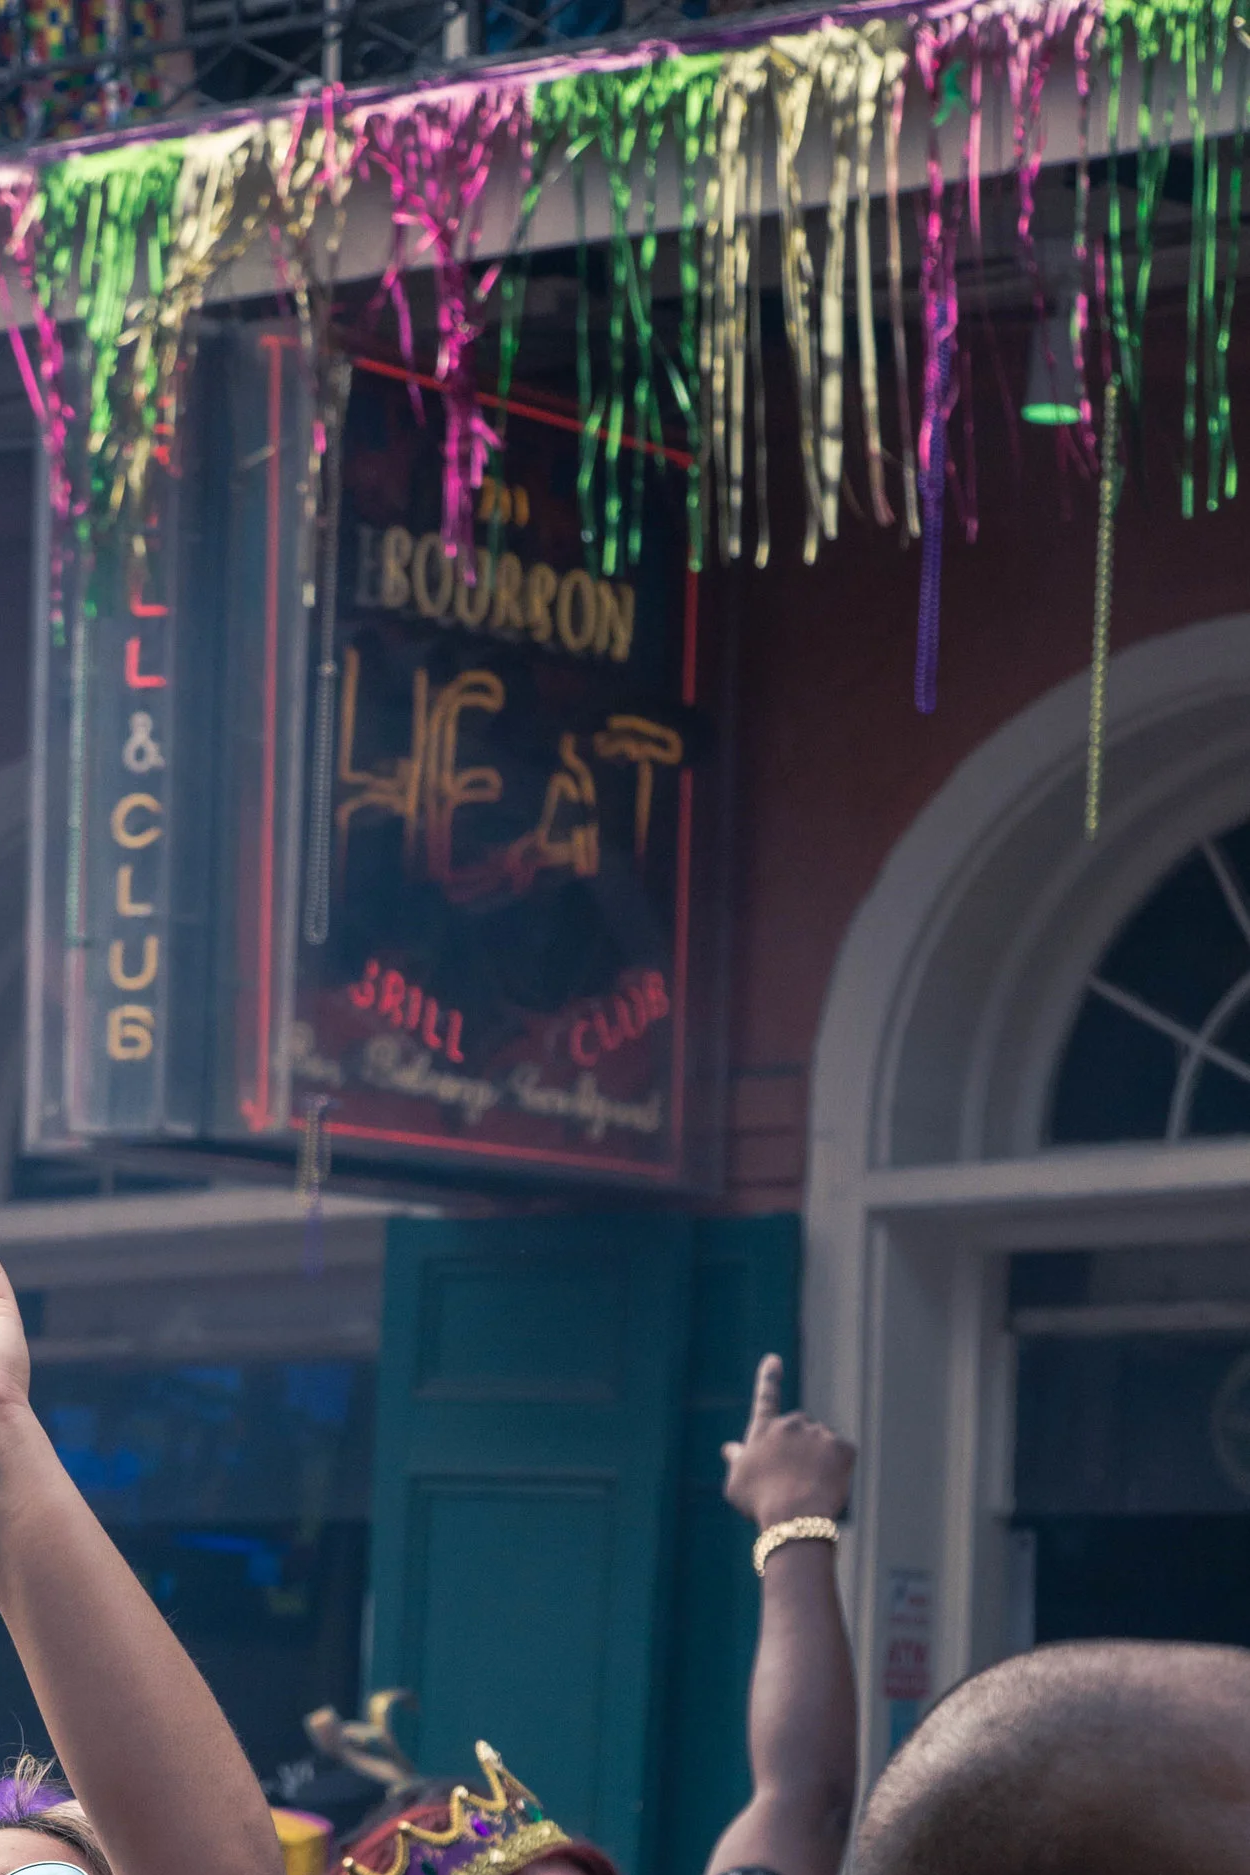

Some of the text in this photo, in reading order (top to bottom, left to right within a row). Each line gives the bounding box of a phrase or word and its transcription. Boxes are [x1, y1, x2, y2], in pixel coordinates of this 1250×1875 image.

[122, 709, 166, 774] &
[107, 792, 164, 1061] CLUB
[569, 970, 671, 1067] CLUB
